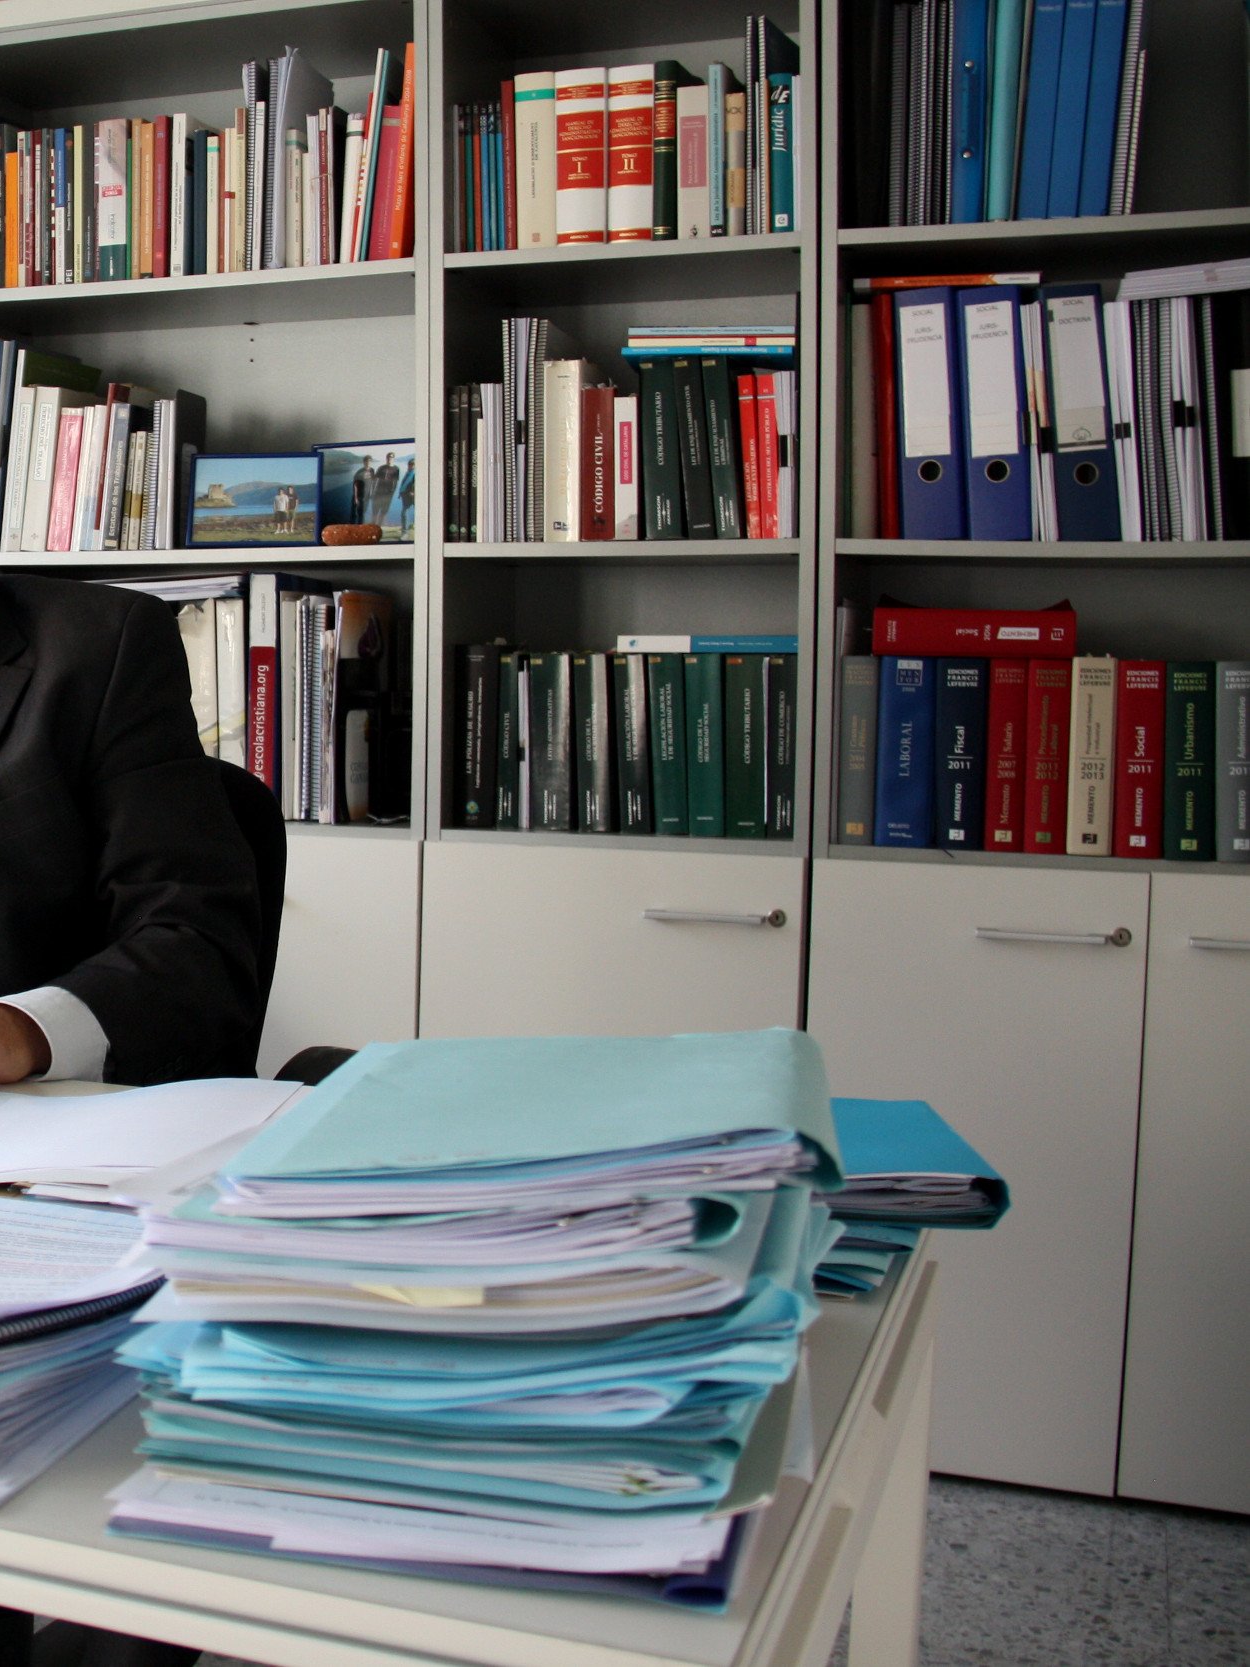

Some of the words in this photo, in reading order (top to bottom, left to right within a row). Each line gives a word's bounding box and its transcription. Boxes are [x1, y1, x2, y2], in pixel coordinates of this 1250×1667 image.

[911, 309, 934, 317] SOCIAL
[976, 304, 999, 313] SOCIAL
[1058, 316, 1092, 326] DOCTRINA
[907, 333, 943, 345] PRUDENCIA
[971, 329, 1009, 341] PRUDENCIA
[655, 391, 664, 435] TRIBUTARIO
[113, 440, 124, 485] Trabajadores
[594, 431, 604, 465] CIVIL
[656, 436, 665, 466] CÓDIGO
[111, 486, 119, 496] los
[111, 496, 118, 505] de
[592, 467, 604, 513] CÓDIGO
[108, 506, 118, 536] Estatuto
[956, 628, 979, 636] Social
[953, 725, 966, 753] Fiscal
[1003, 722, 1014, 752] Salario
[1135, 725, 1146, 757] Social
[1184, 702, 1195, 759] Urbanismo
[1236, 696, 1247, 759] Administrativo
[743, 734, 751, 764] CÓDIGO
[899, 720, 913, 777] LABORAL
[948, 761, 971, 769] 2011
[1080, 771, 1105, 780] 2013
[1081, 763, 1105, 771] 2012
[1128, 764, 1152, 773] 2011
[1176, 767, 1202, 776] 2011
[953, 783, 963, 821] MEMENTO
[999, 784, 1010, 824] Memento
[1087, 785, 1096, 824] MEMENTO
[1134, 787, 1144, 827] MEMENTO
[1185, 790, 1194, 830] MEMENTO
[1238, 789, 1247, 829] MEMENTO
